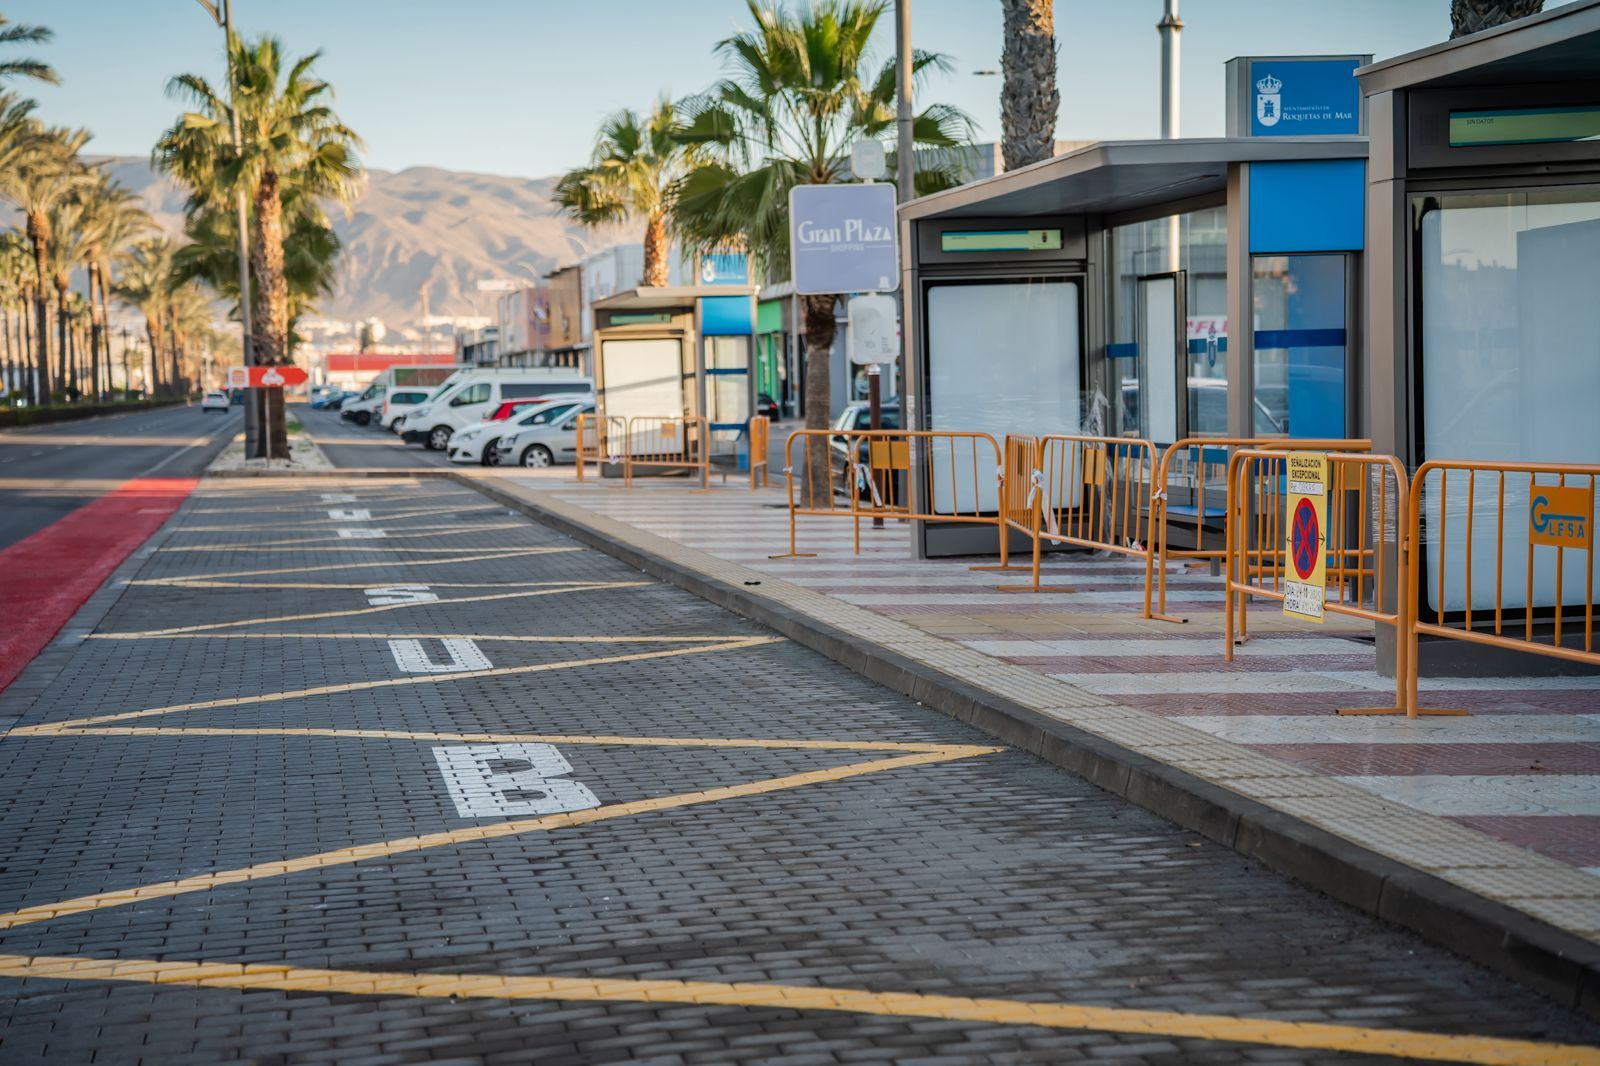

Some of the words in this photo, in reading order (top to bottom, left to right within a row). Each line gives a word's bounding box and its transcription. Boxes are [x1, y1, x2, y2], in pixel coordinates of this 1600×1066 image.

[1282, 112, 1320, 121] ROQUETAS
[1335, 112, 1352, 120] MAR
[797, 220, 840, 244] Gran
[1291, 469, 1321, 480] EXCEPCIONAL
